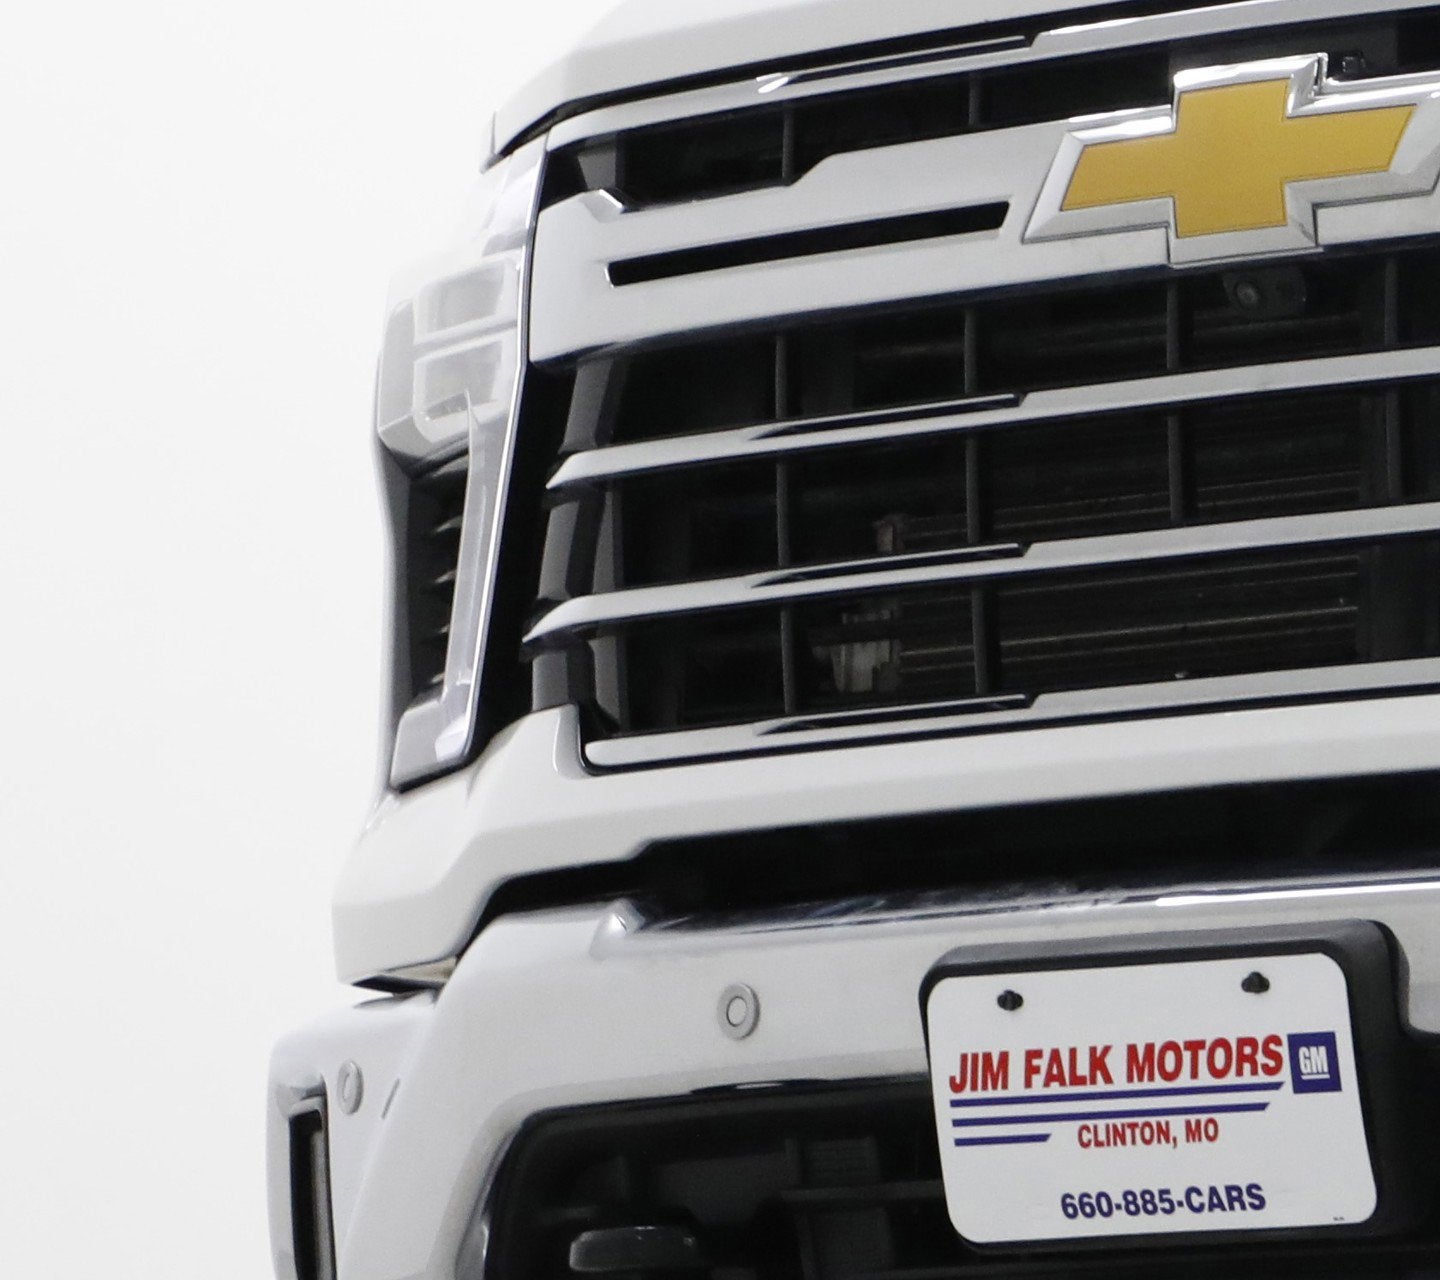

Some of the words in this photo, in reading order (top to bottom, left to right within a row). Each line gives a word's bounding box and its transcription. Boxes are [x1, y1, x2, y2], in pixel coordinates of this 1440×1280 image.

[949, 1051, 1010, 1094] JIM
[1024, 1045, 1114, 1089] FALK
[1127, 1034, 1285, 1084] MOTORS
[1298, 1045, 1330, 1074] GM
[1077, 1120, 1178, 1150] CLINTON,
[1185, 1117, 1219, 1144] MO
[1060, 1183, 1268, 1221] 660-885-CARS
